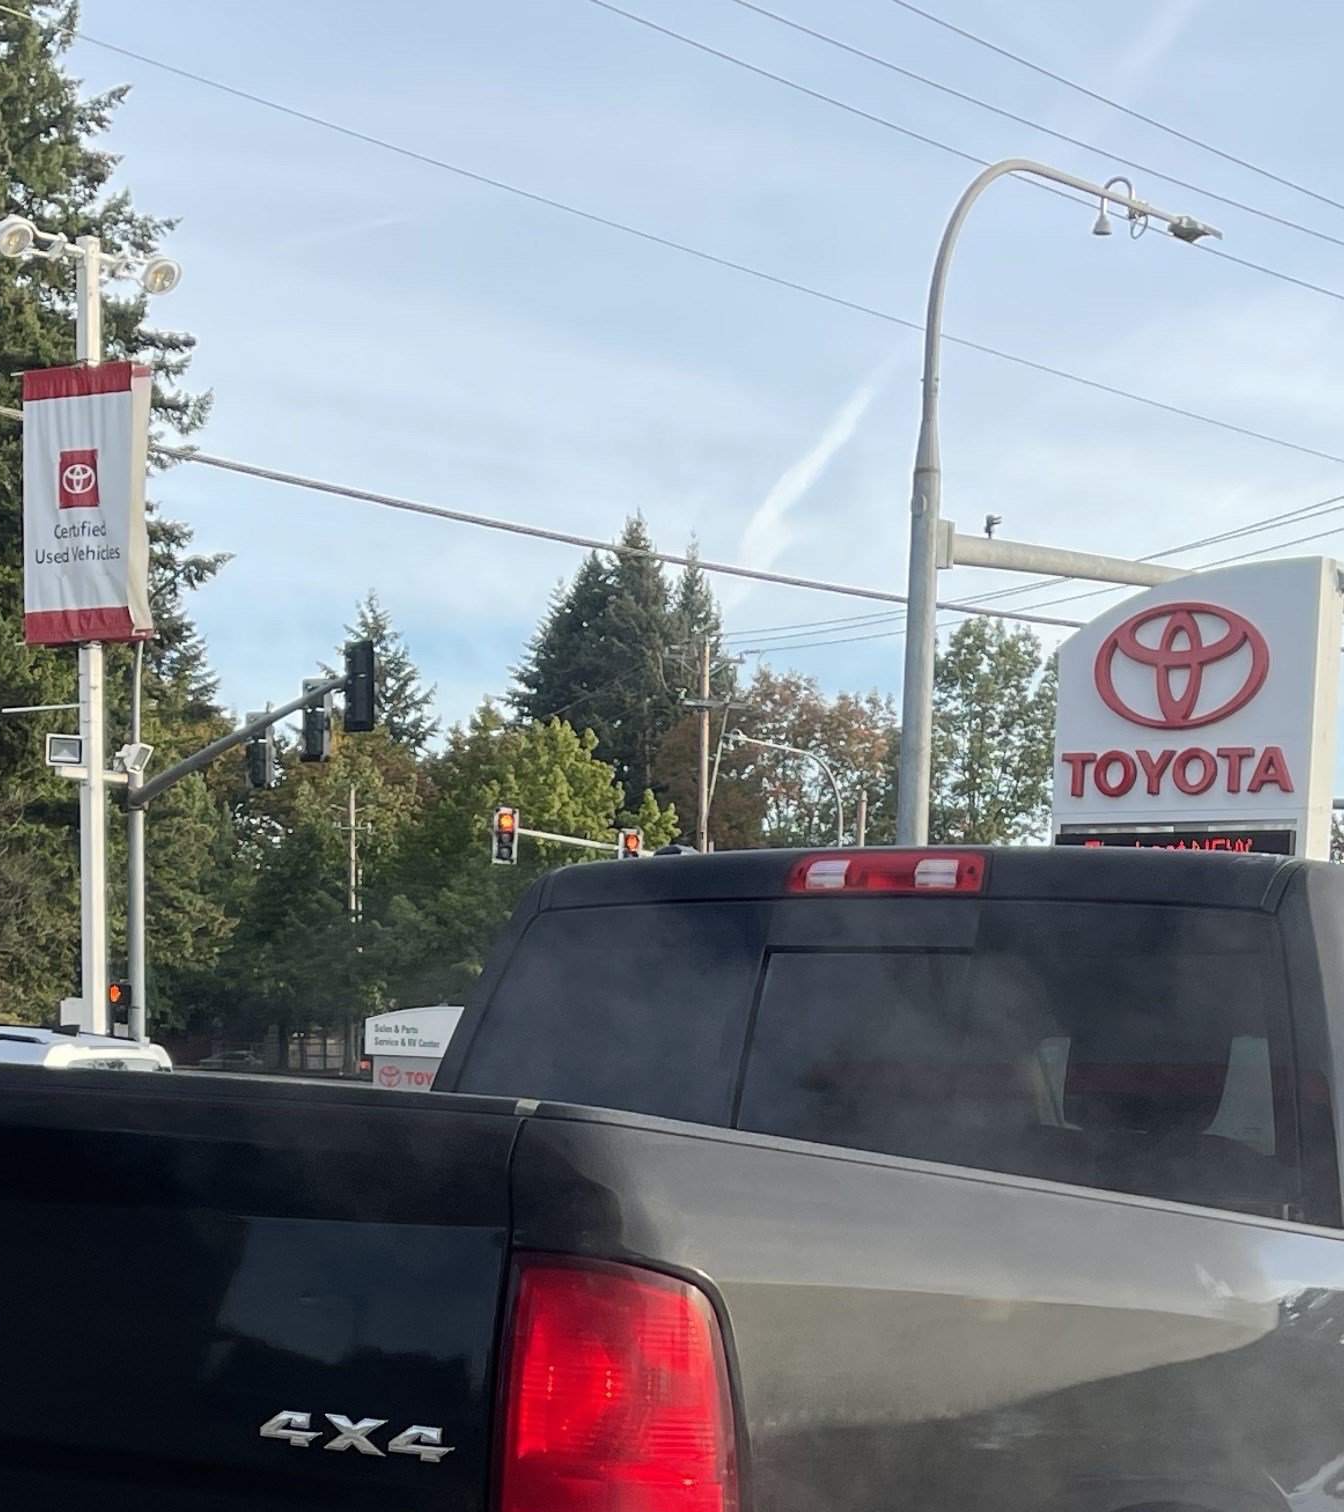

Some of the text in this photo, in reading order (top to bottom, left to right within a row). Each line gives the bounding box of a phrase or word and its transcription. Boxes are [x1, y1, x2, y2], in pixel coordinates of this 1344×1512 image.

[54, 520, 107, 540] Certified
[35, 544, 120, 565] Used Vehicles
[1062, 746, 1294, 798] TOYOTA
[260, 1410, 455, 1463] 4X4
